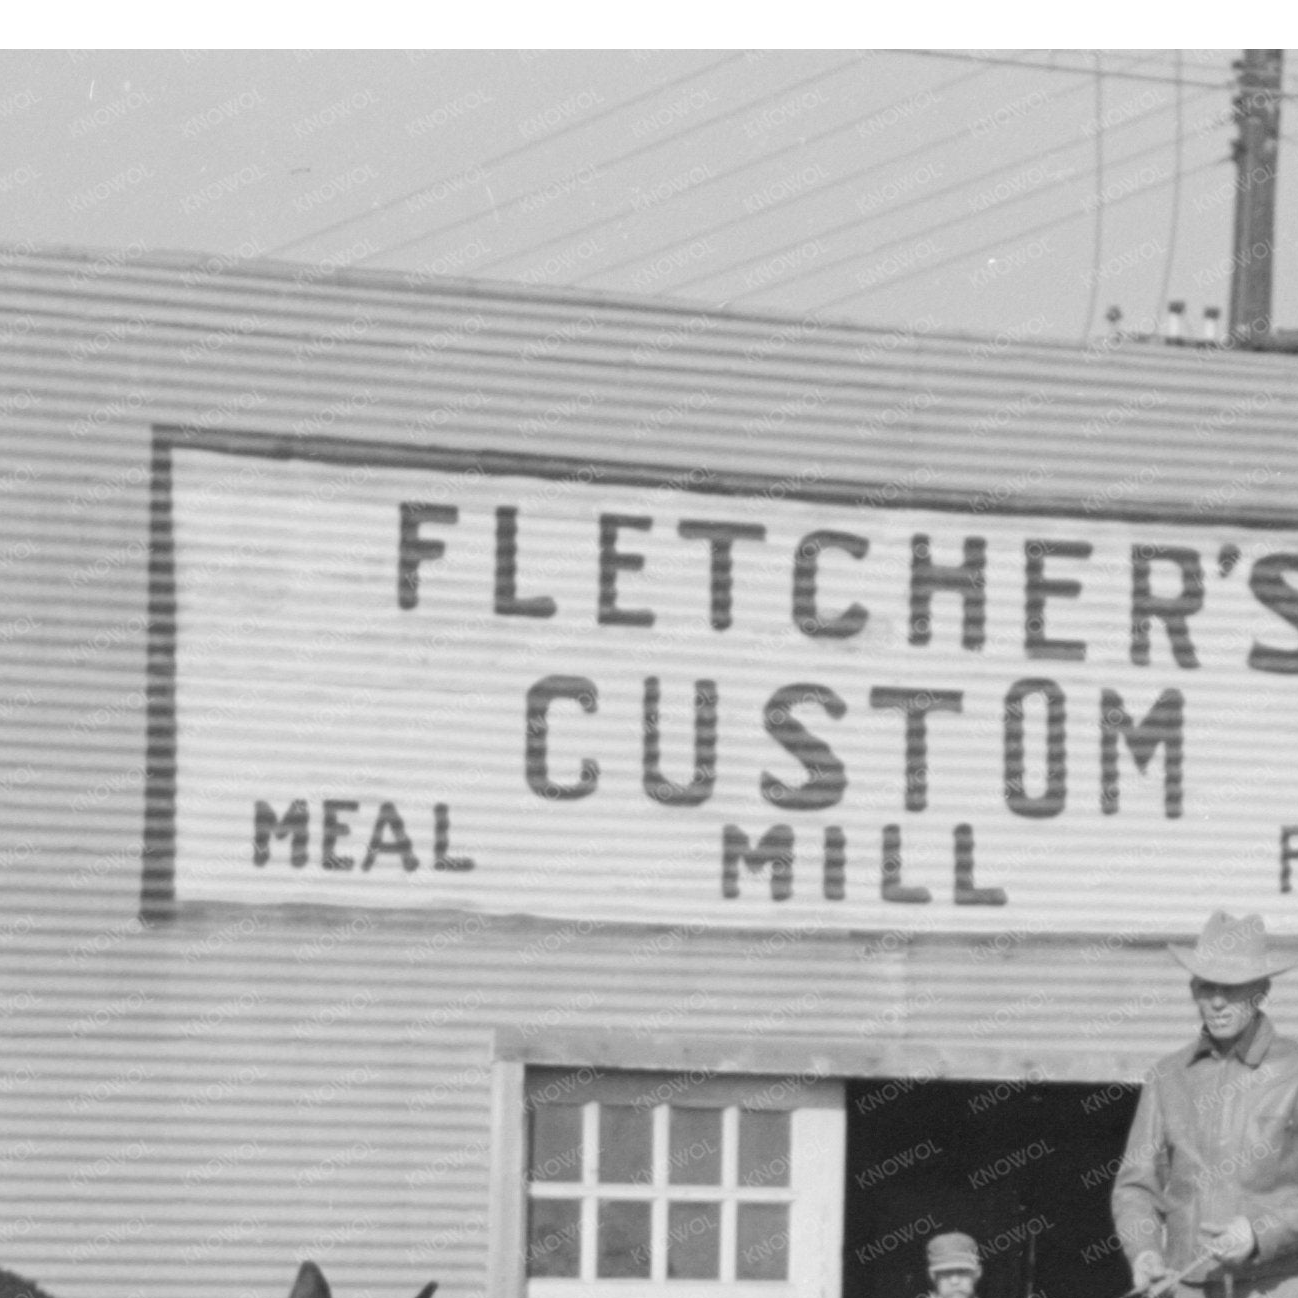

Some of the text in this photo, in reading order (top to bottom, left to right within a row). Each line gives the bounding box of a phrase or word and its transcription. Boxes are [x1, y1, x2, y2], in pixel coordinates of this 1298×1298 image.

[525, 675, 1184, 819] CUSTOM
[252, 799, 475, 873] MEAL
[721, 823, 1007, 907] MILL
